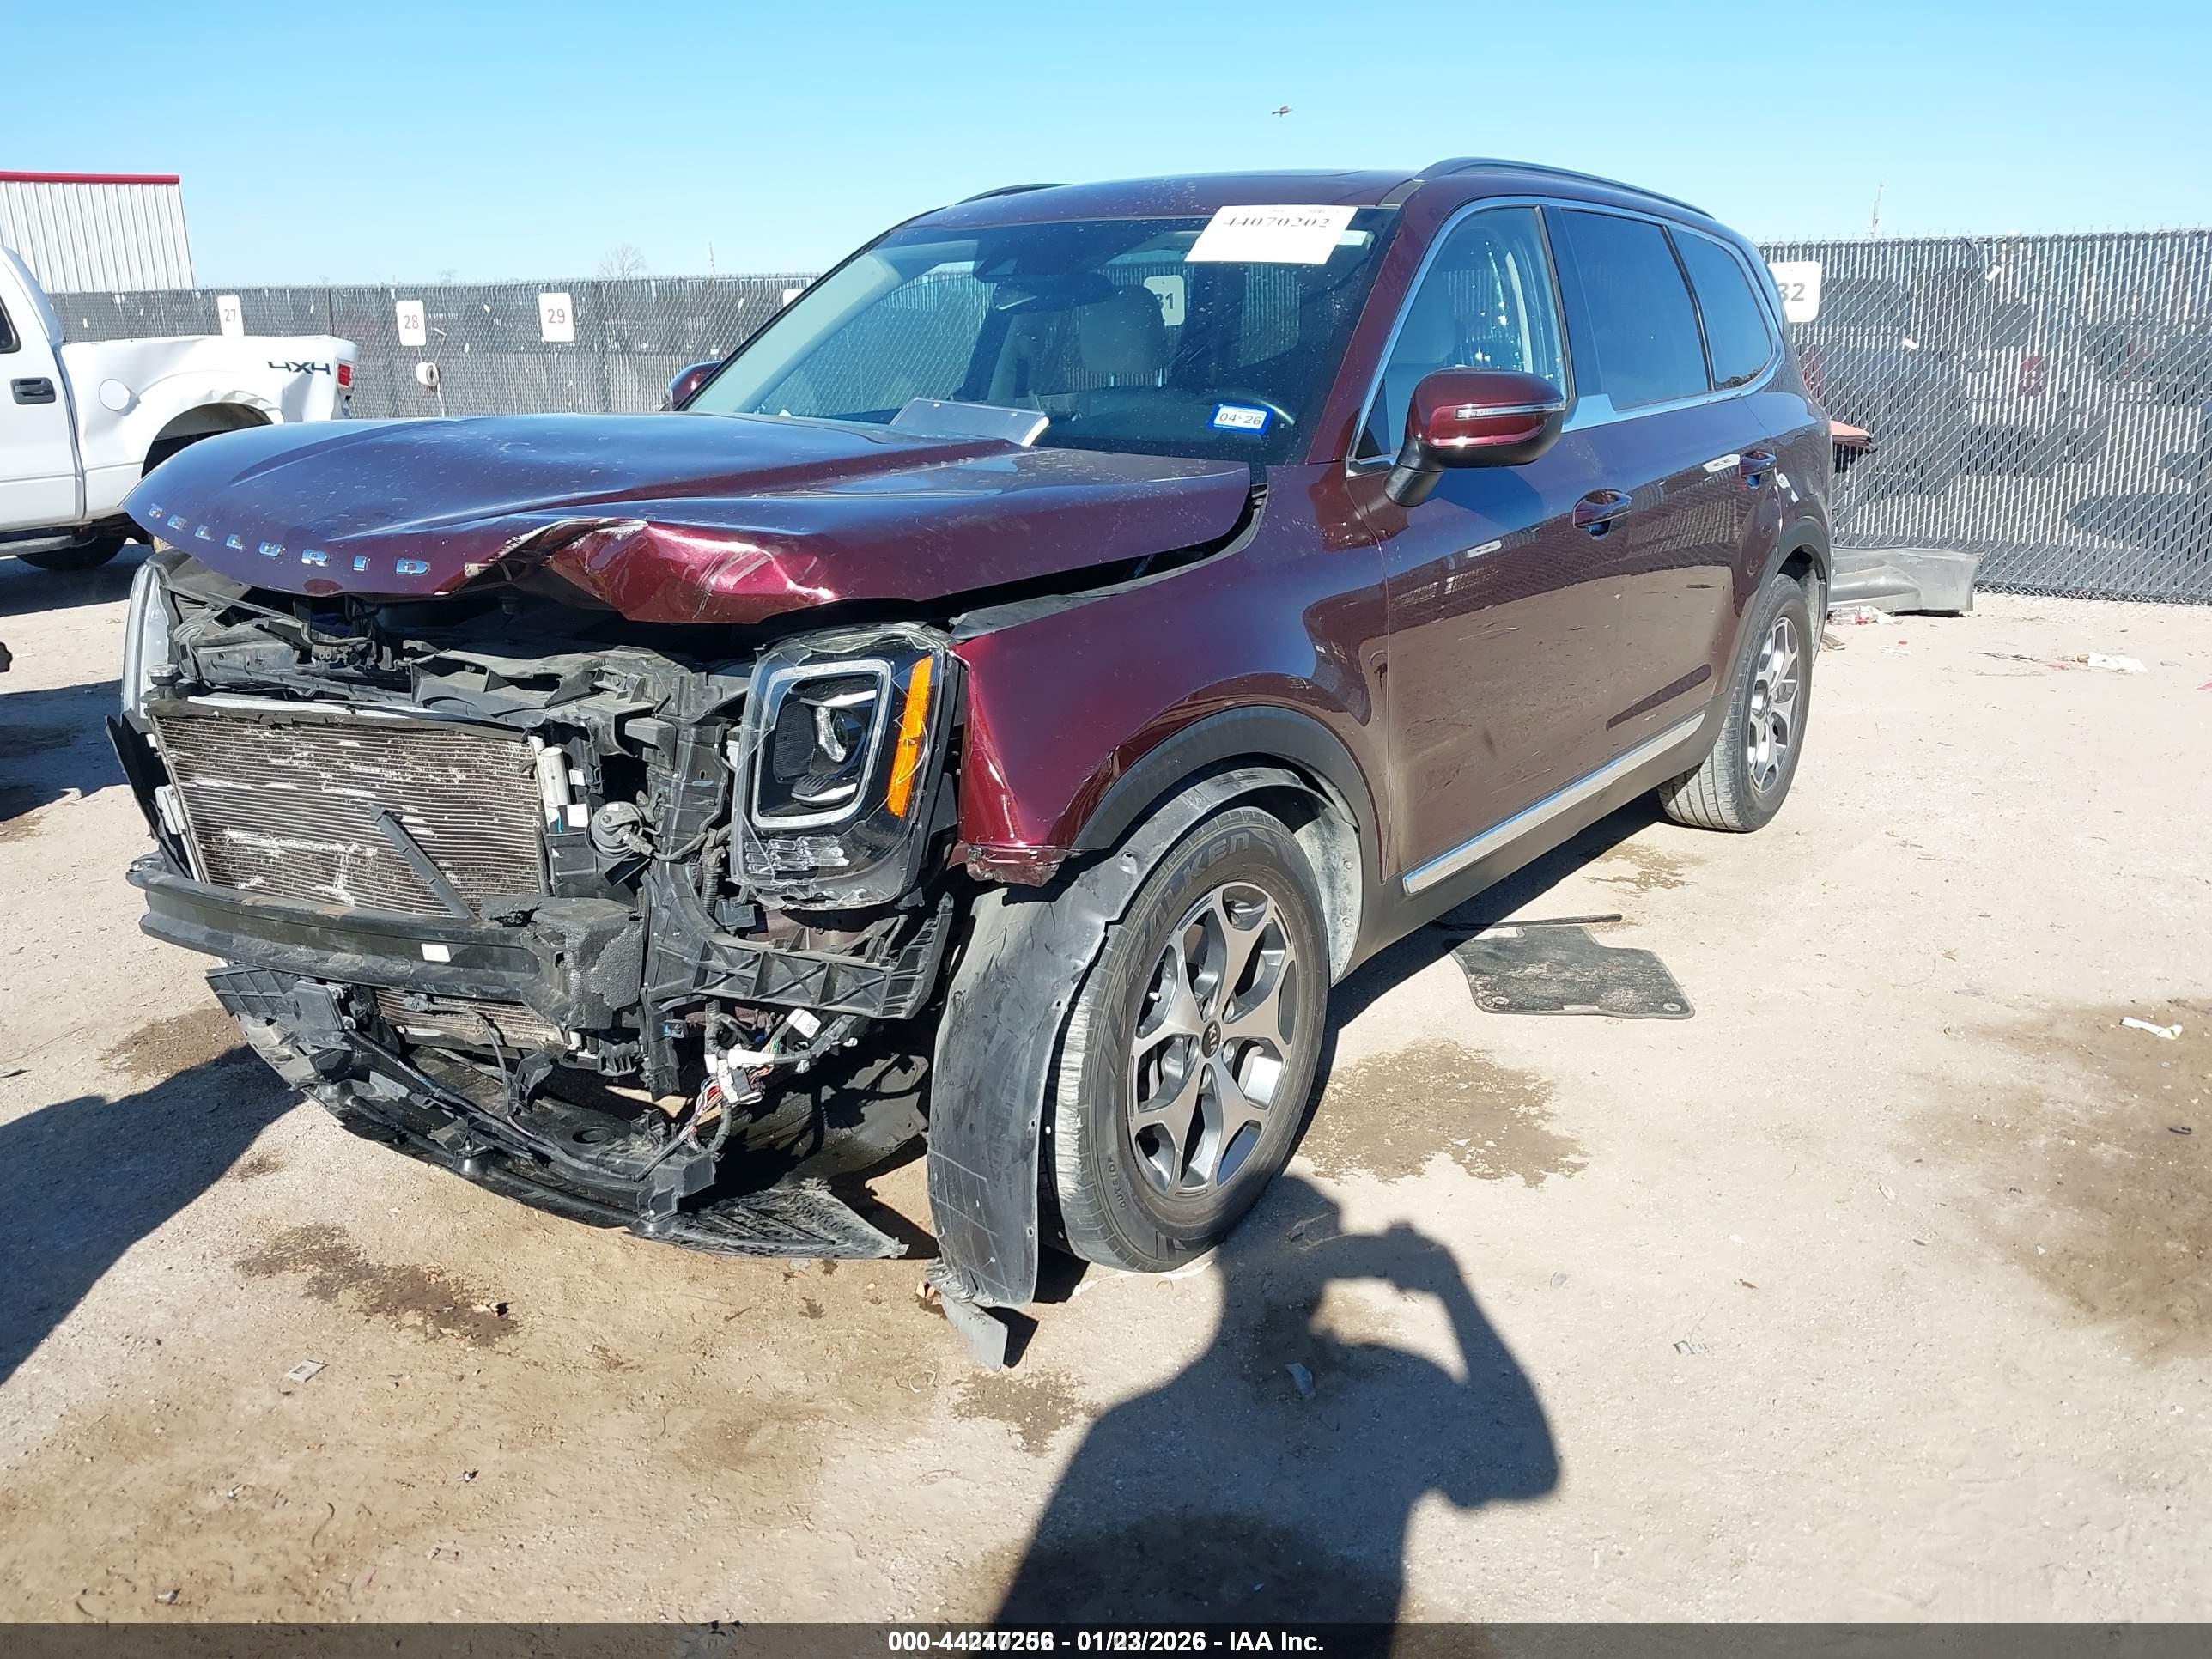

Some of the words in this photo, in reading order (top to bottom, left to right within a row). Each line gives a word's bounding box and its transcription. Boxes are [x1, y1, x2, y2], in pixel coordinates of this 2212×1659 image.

[1778, 282, 1806, 301] 32
[224, 308, 236, 322] 27
[404, 315, 419, 330] 28
[547, 308, 566, 324] 29
[1243, 415, 1262, 425] 26
[1207, 1023, 1218, 1056] KIA
